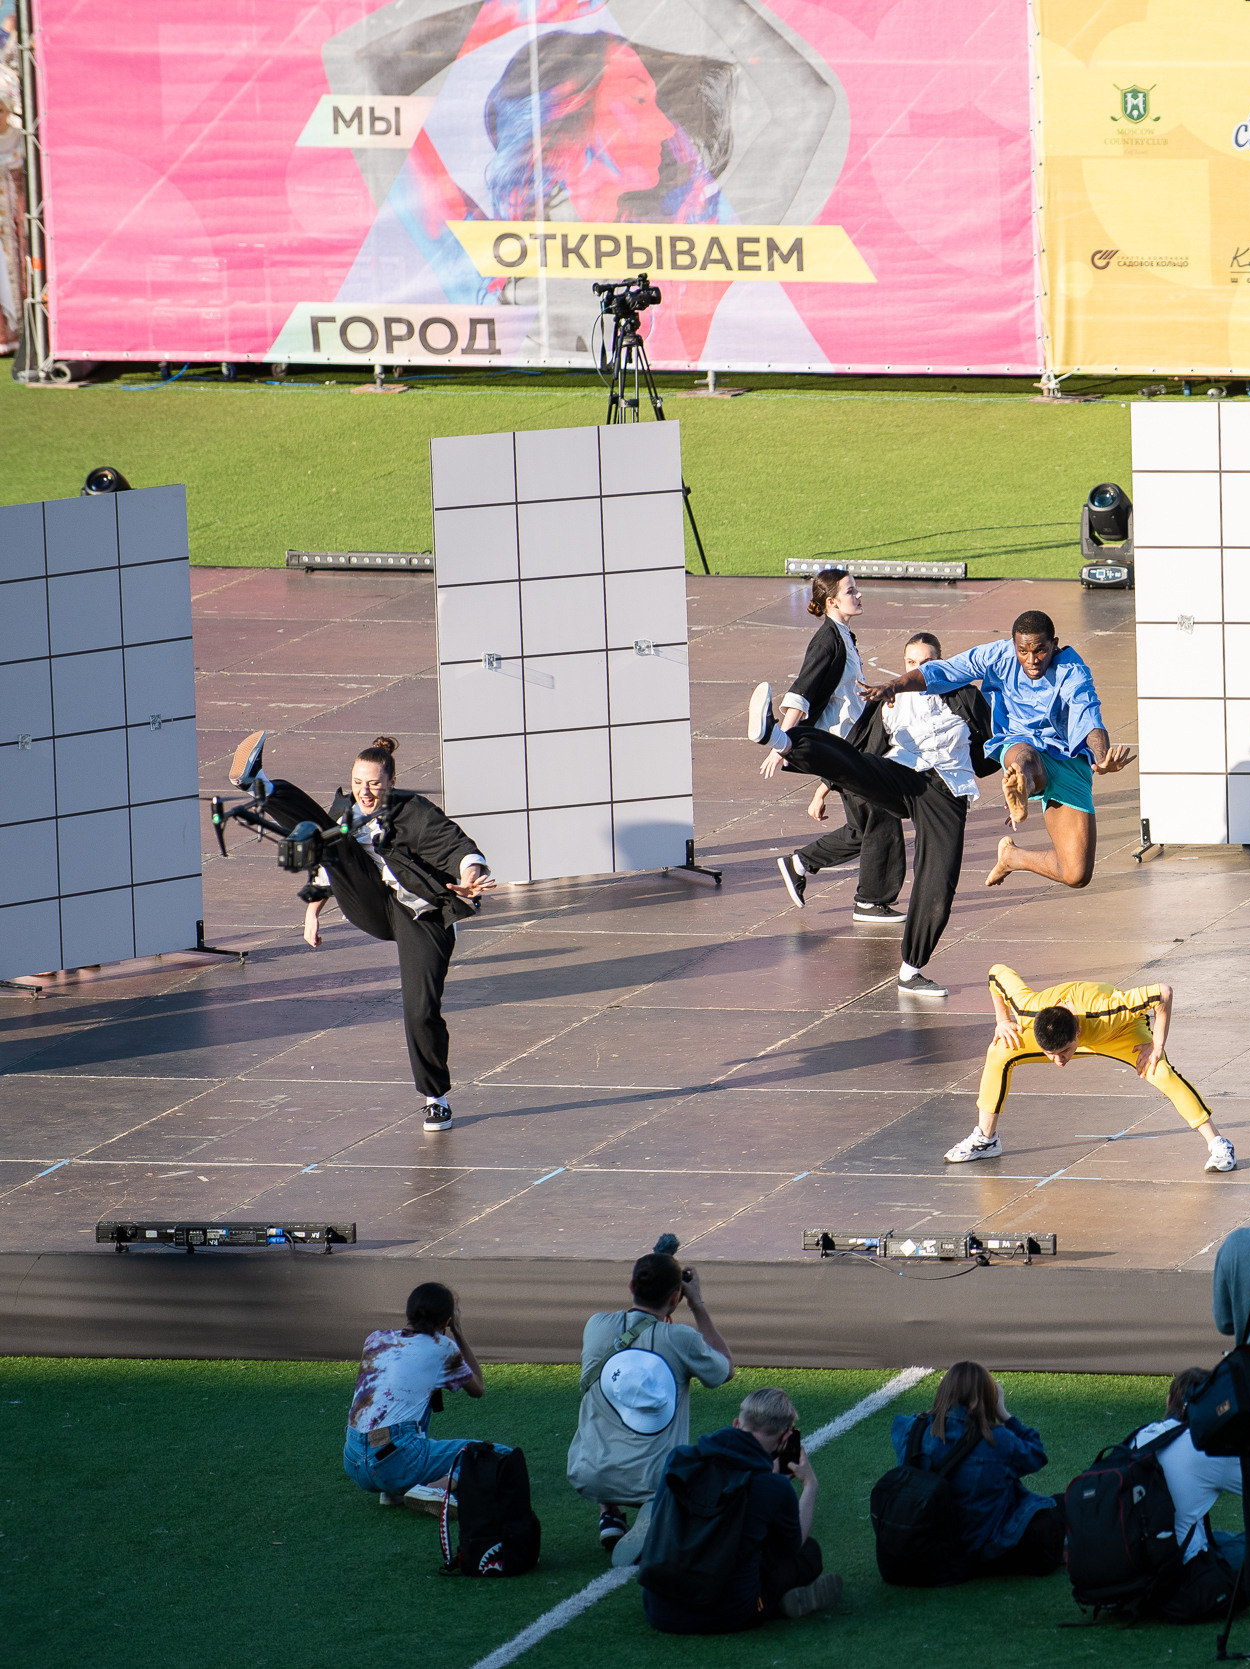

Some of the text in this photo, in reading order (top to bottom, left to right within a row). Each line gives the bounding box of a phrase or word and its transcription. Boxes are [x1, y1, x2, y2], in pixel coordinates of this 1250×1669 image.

[332, 105, 401, 136] МЫ
[491, 232, 805, 272] ОТКРЫВАЕМ
[1156, 260, 1190, 268] КОЛЬЦО
[310, 315, 502, 356] ГОРОД
